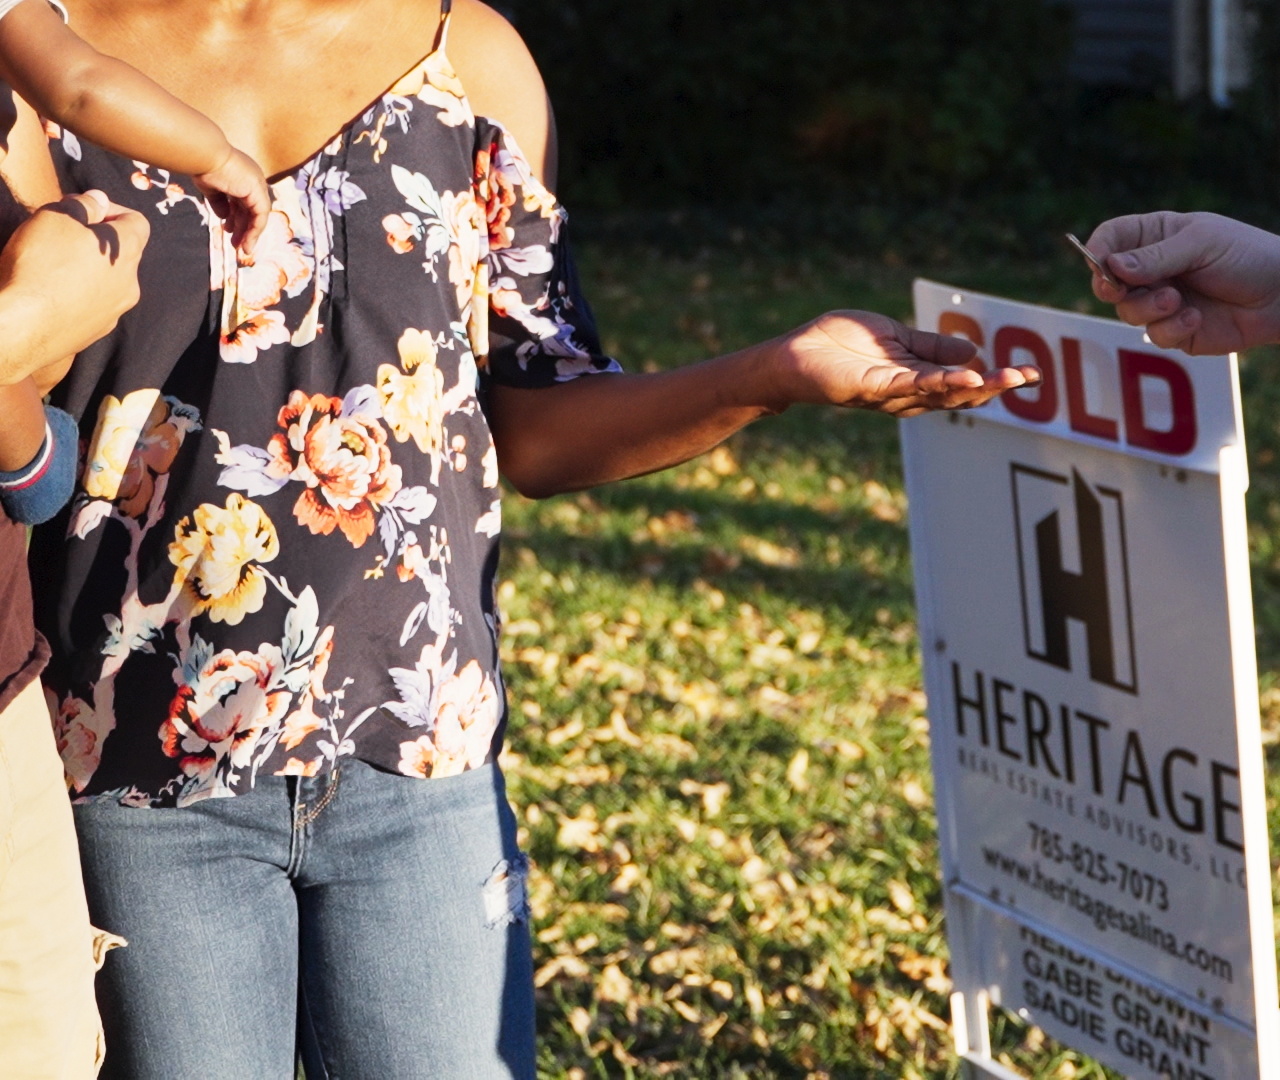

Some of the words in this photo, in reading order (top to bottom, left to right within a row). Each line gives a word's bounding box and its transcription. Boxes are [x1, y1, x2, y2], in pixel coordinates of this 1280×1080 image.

[951, 661, 1246, 856] HERITAGE
[958, 748, 1001, 784] REAL
[1006, 769, 1077, 818] ESTATE
[982, 845, 1234, 984] www.heritagesalina.com
[1028, 821, 1170, 912] 785-825-7073
[1022, 950, 1104, 1010] GABE
[1111, 992, 1213, 1066] GRANT
[1022, 978, 1108, 1045] SADIE
